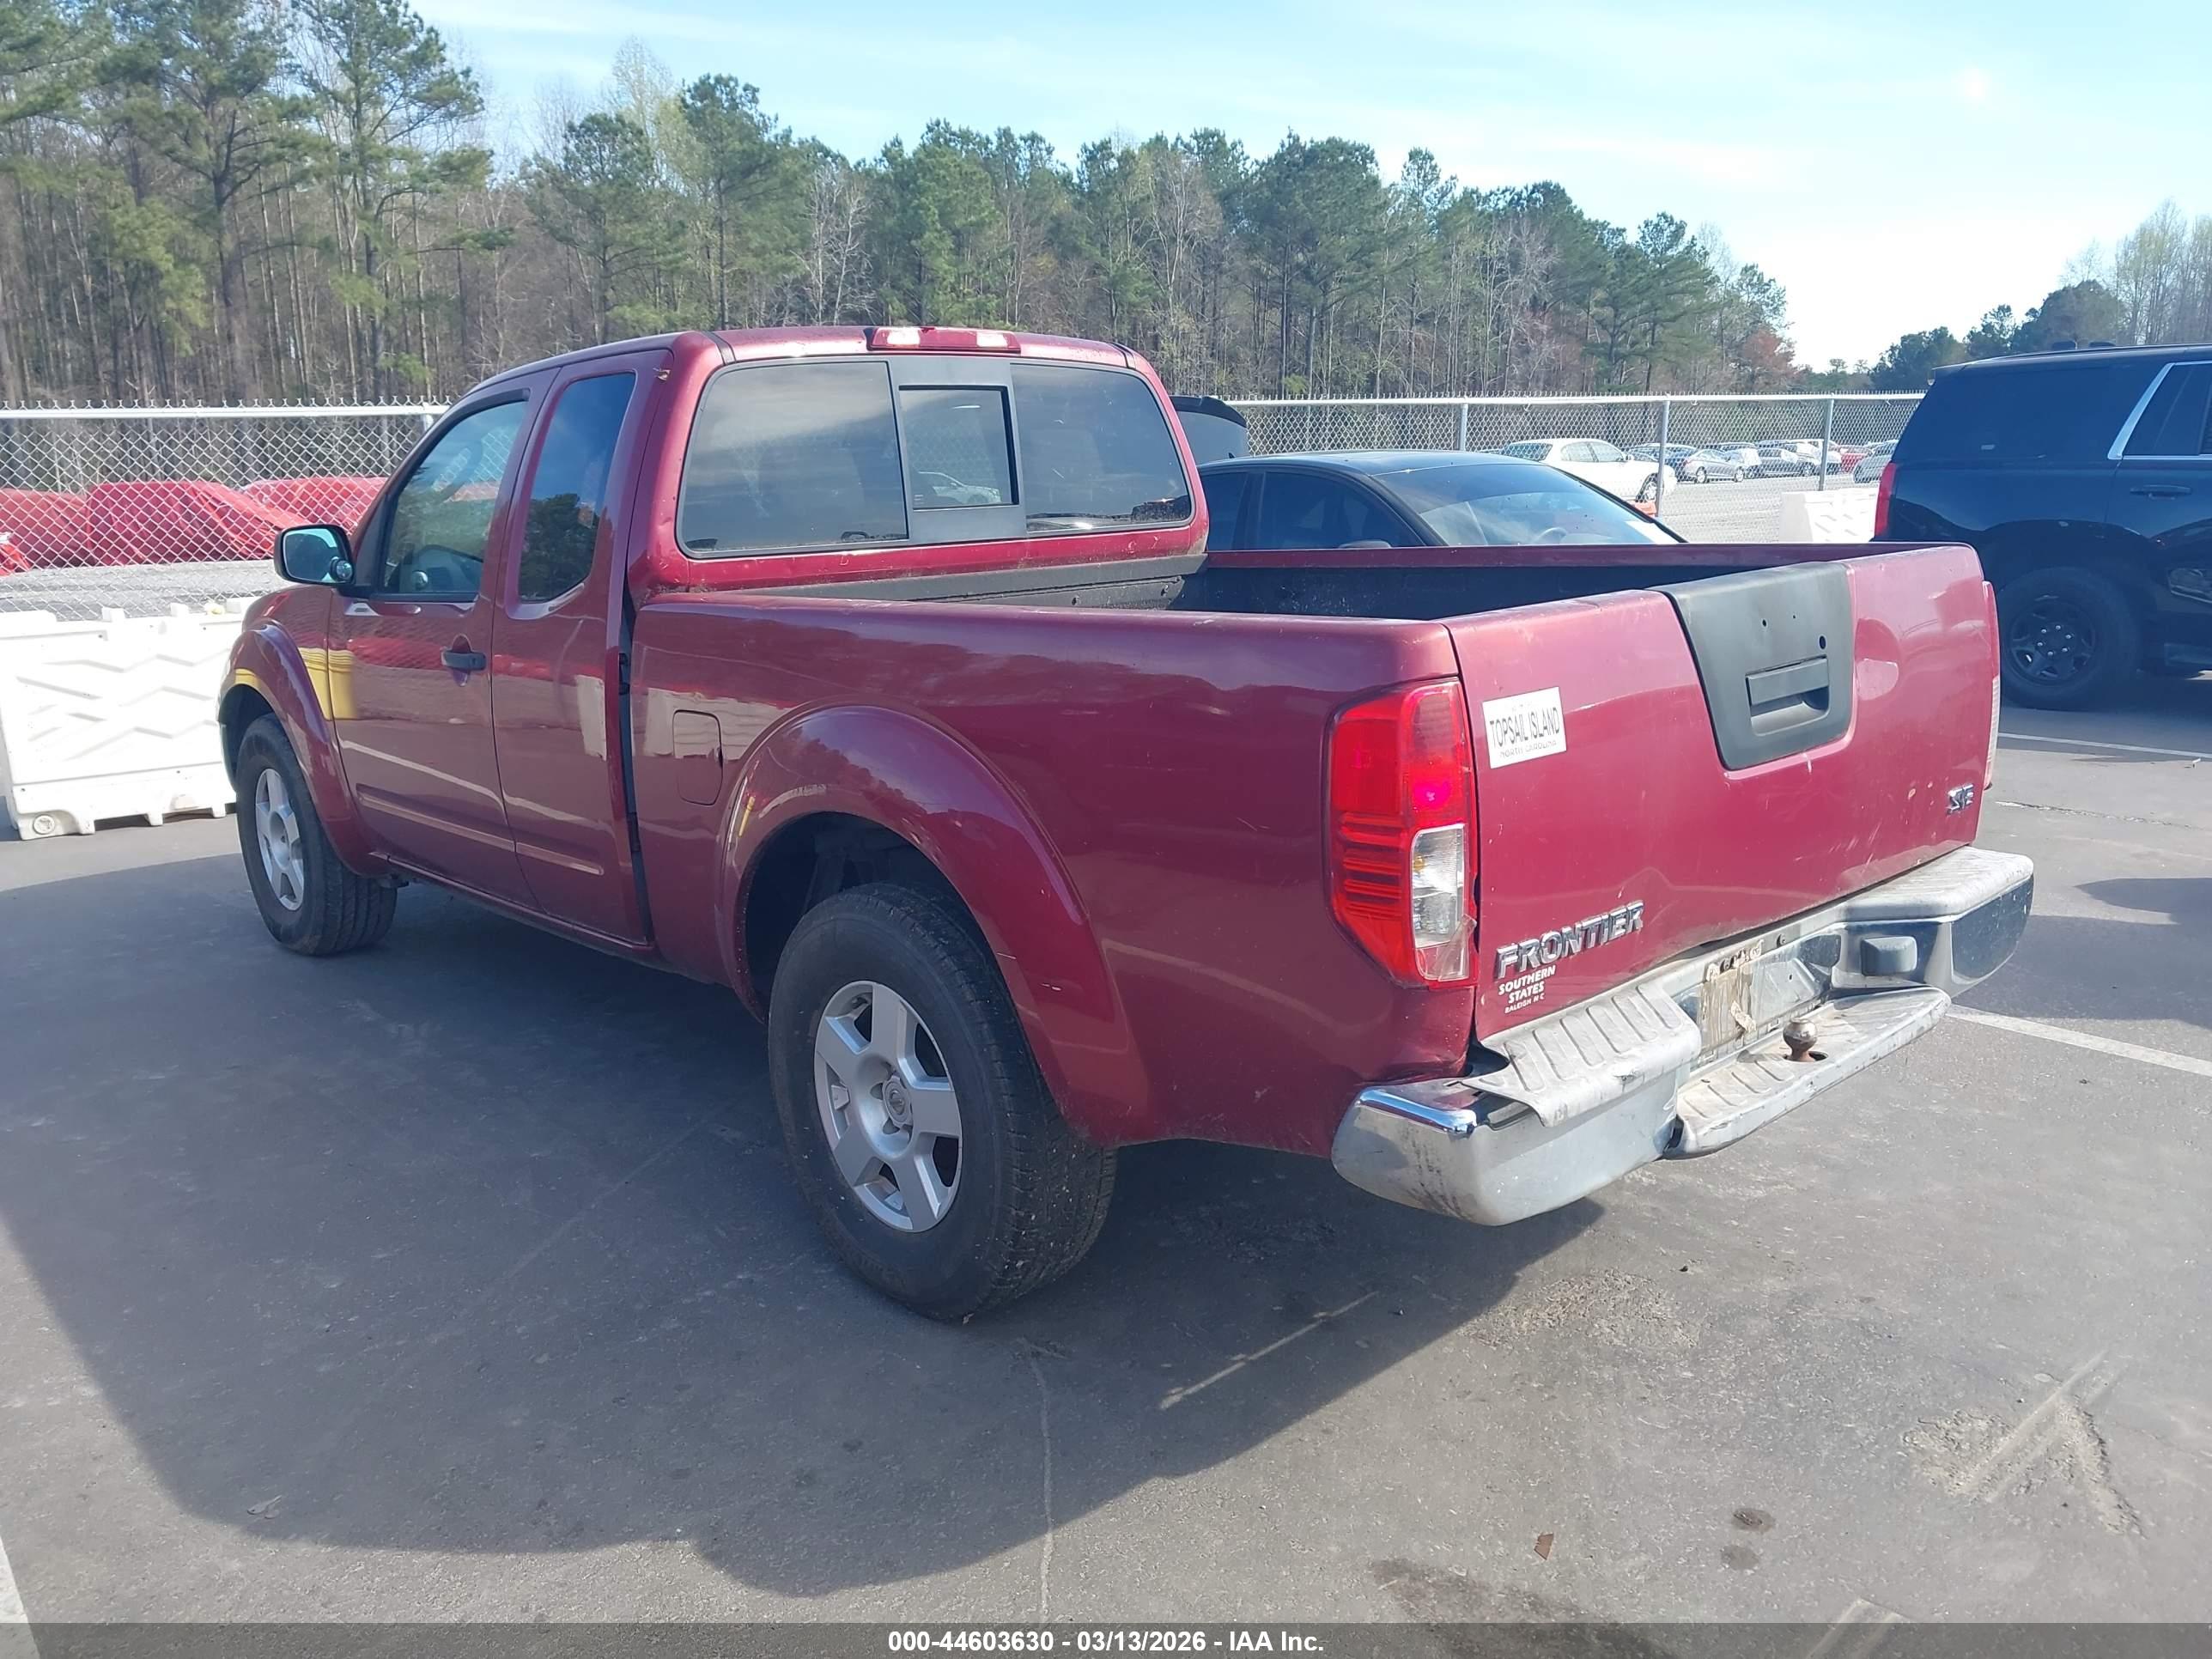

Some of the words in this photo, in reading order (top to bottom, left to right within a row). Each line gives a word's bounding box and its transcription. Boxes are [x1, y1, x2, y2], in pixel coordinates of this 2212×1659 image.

[1490, 714, 1528, 748] TOPSAIL
[1528, 707, 1560, 739] ISLAND
[1499, 746, 1523, 758] NORTH
[1525, 740, 1557, 752] CAROLINA
[1495, 901, 1644, 980] FRONTIER
[1498, 964, 1556, 996] SOUTHERN
[1508, 981, 1545, 1004] STATES
[1504, 998, 1532, 1014] RALEIGH
